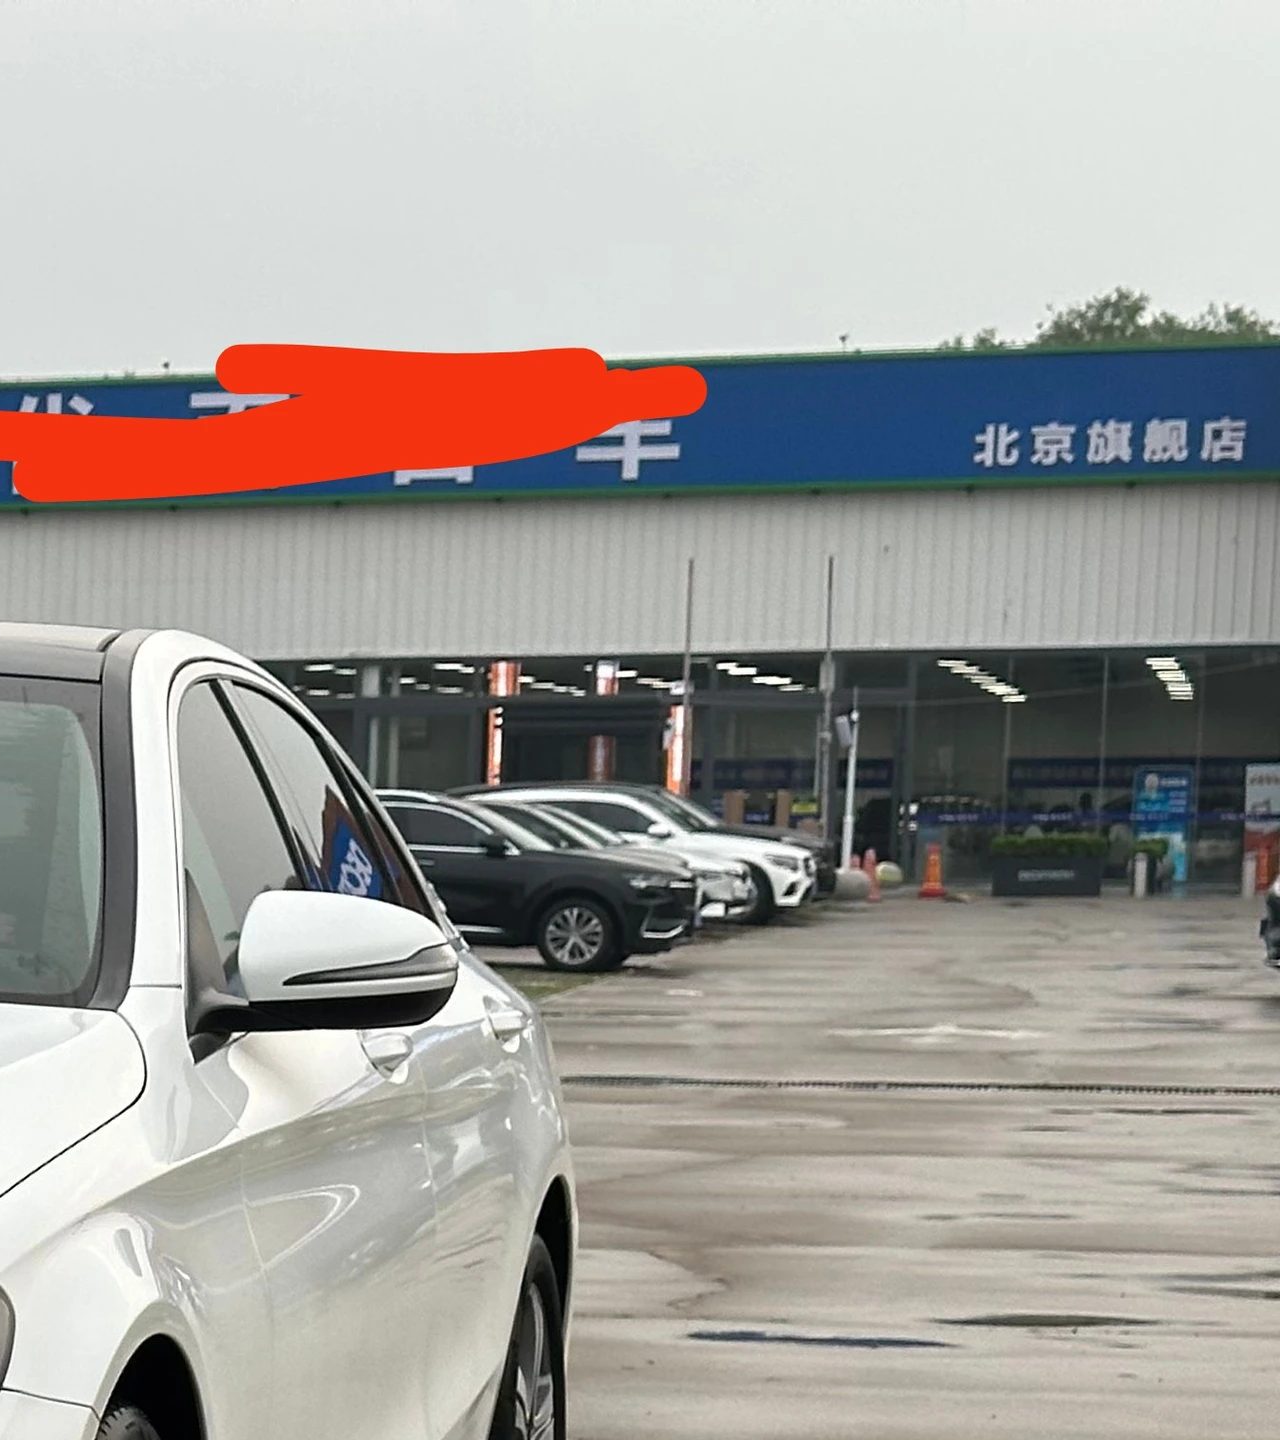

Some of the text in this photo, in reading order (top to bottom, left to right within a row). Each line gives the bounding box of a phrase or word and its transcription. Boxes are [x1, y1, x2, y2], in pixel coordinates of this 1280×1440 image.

[973, 417, 1247, 467] 北京旗舰店
